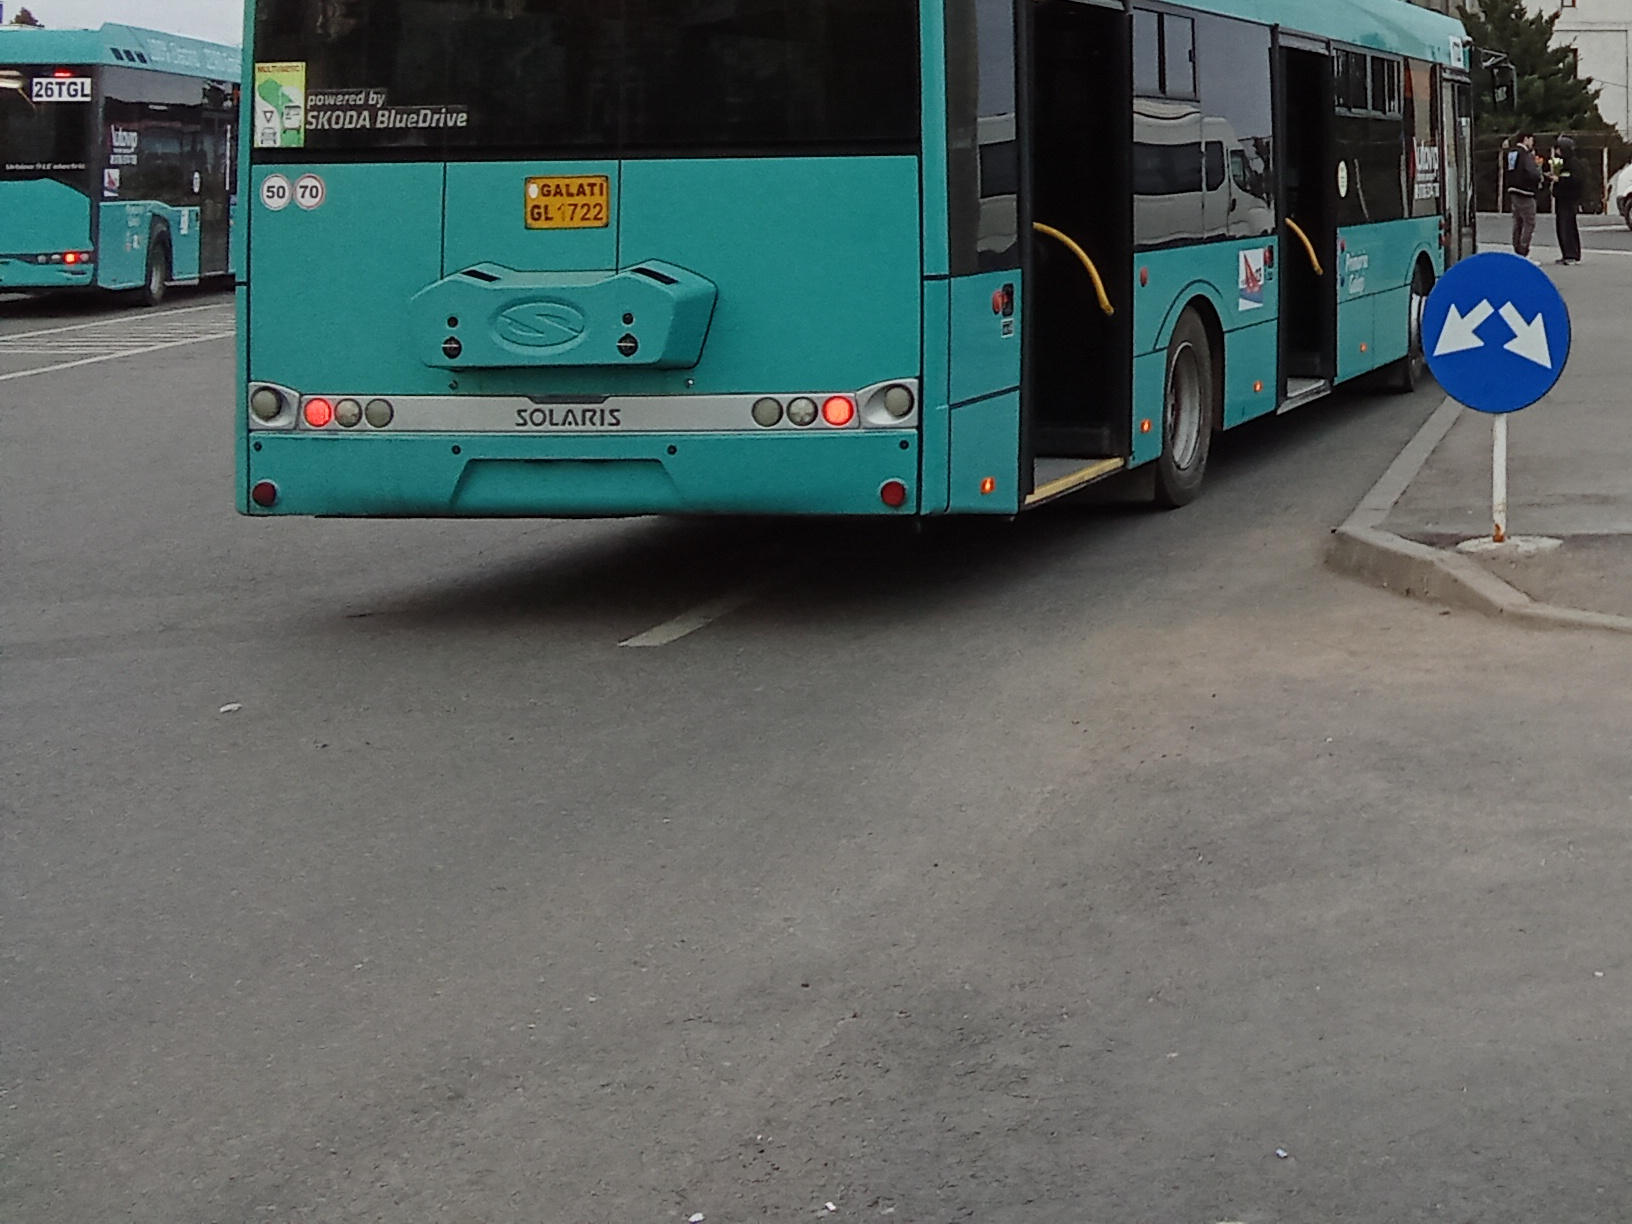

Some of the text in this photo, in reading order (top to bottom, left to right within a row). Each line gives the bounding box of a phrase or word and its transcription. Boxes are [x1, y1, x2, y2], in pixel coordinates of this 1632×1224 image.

[34, 81, 91, 98] 26TGL
[306, 90, 386, 109] powered by
[306, 107, 468, 130] SKODA BlueDrive
[266, 185, 287, 199] 50
[299, 185, 319, 199] 70
[541, 183, 604, 197] GALATI
[530, 204, 554, 222] GL
[515, 408, 621, 427] SOLARIS
